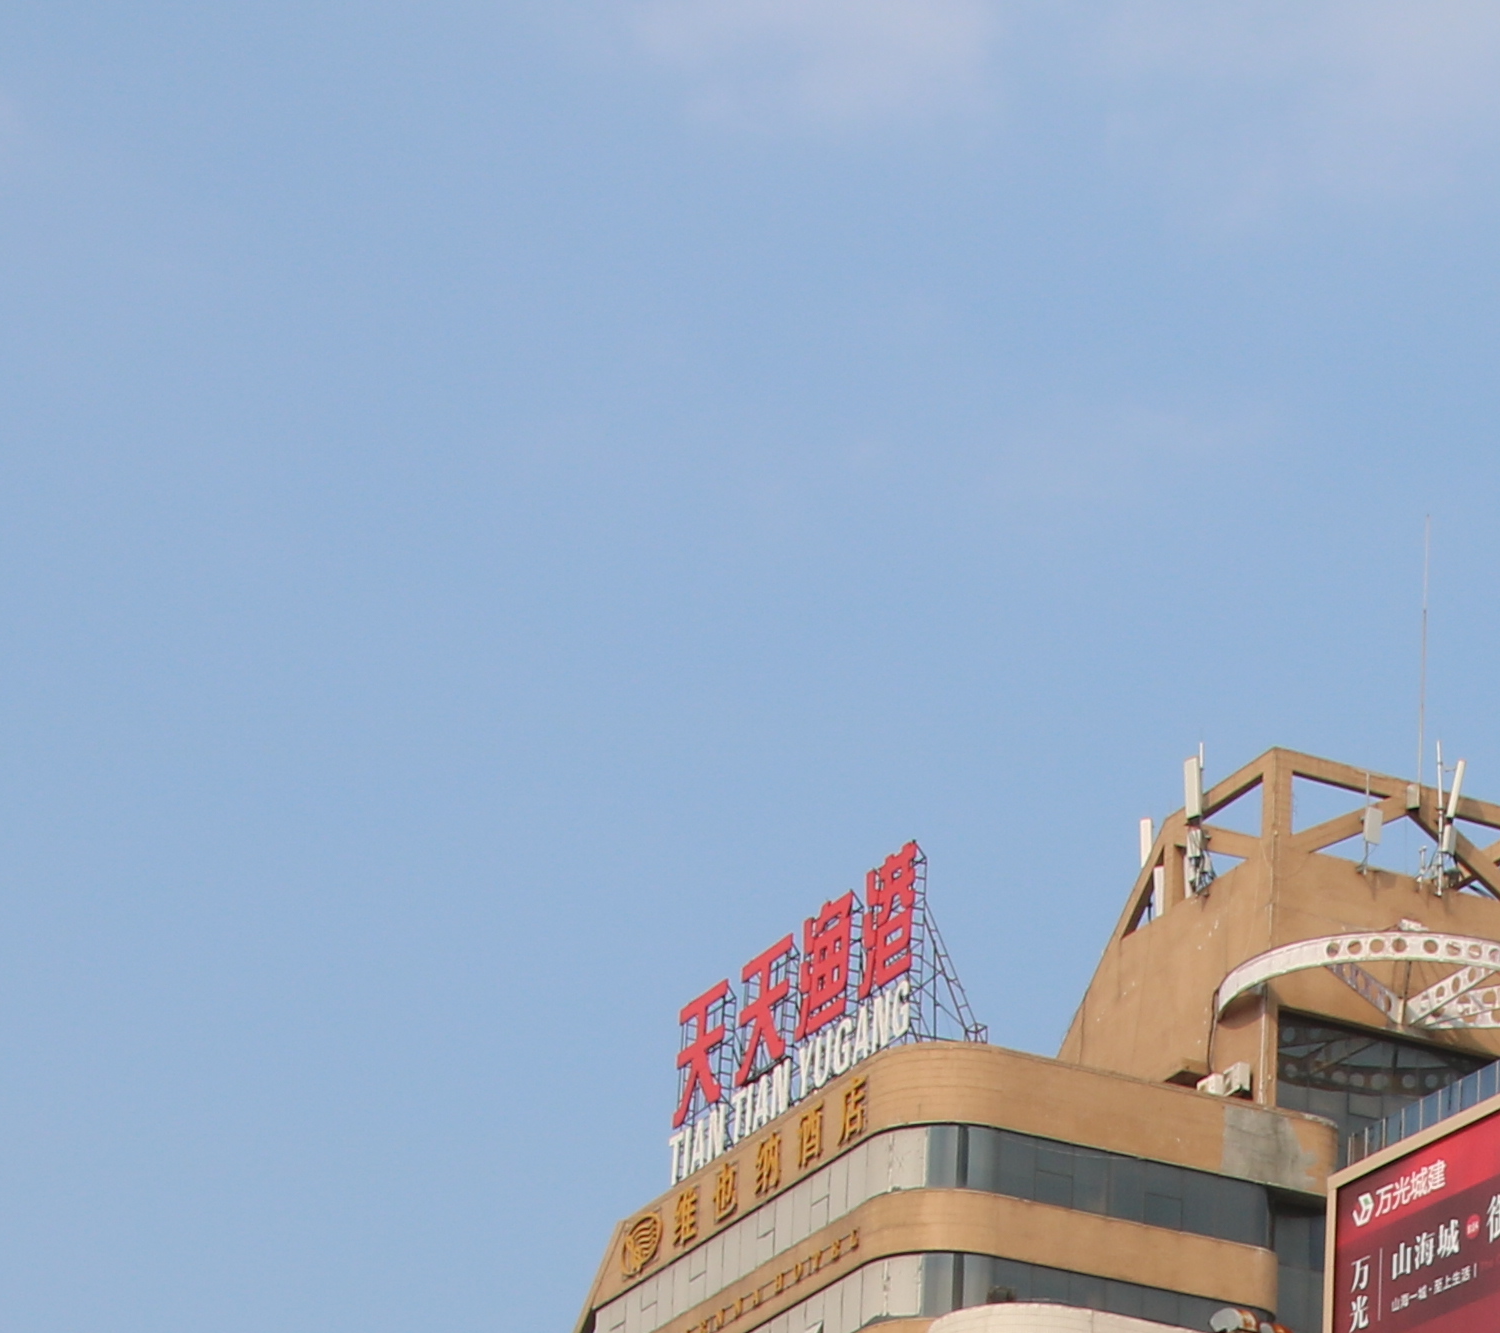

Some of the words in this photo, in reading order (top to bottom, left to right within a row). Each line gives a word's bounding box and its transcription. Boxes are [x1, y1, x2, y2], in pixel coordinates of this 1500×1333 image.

[668, 1109, 728, 1187] TIAN
[730, 1057, 793, 1146] TIAN
[798, 979, 912, 1094] YUGANG
[672, 1074, 869, 1247] 维也纳酒店
[1374, 1159, 1448, 1218] 万光城建
[1390, 1219, 1460, 1280] 山海城
[1349, 1255, 1371, 1333] 万光
